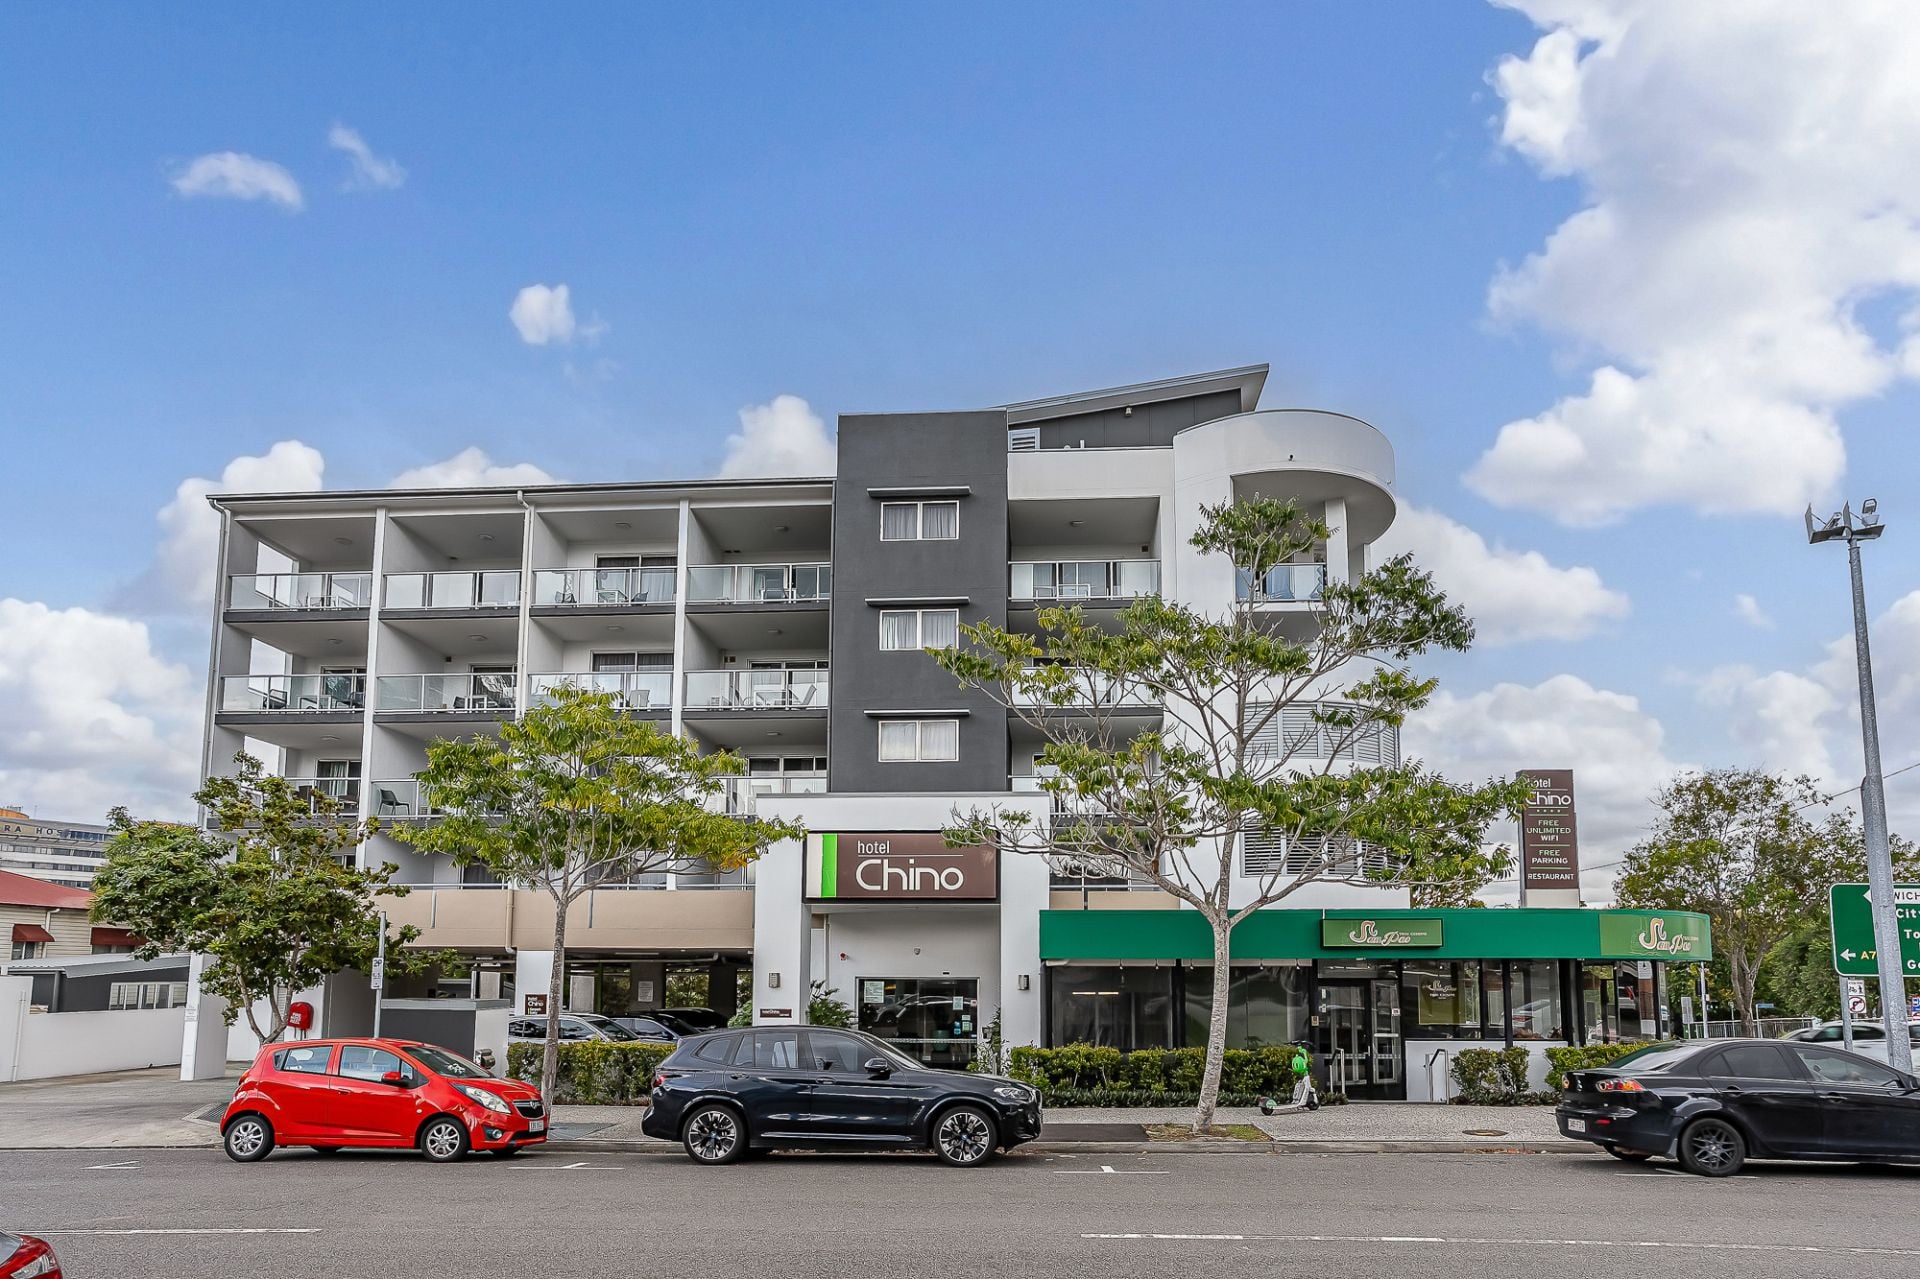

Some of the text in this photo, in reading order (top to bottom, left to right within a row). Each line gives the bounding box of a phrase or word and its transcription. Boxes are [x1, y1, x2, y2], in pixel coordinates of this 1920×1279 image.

[857, 840, 890, 854] hotel
[855, 858, 964, 891] Chino
[1895, 908, 1920, 919] Cit
[1860, 951, 1877, 960] A7
